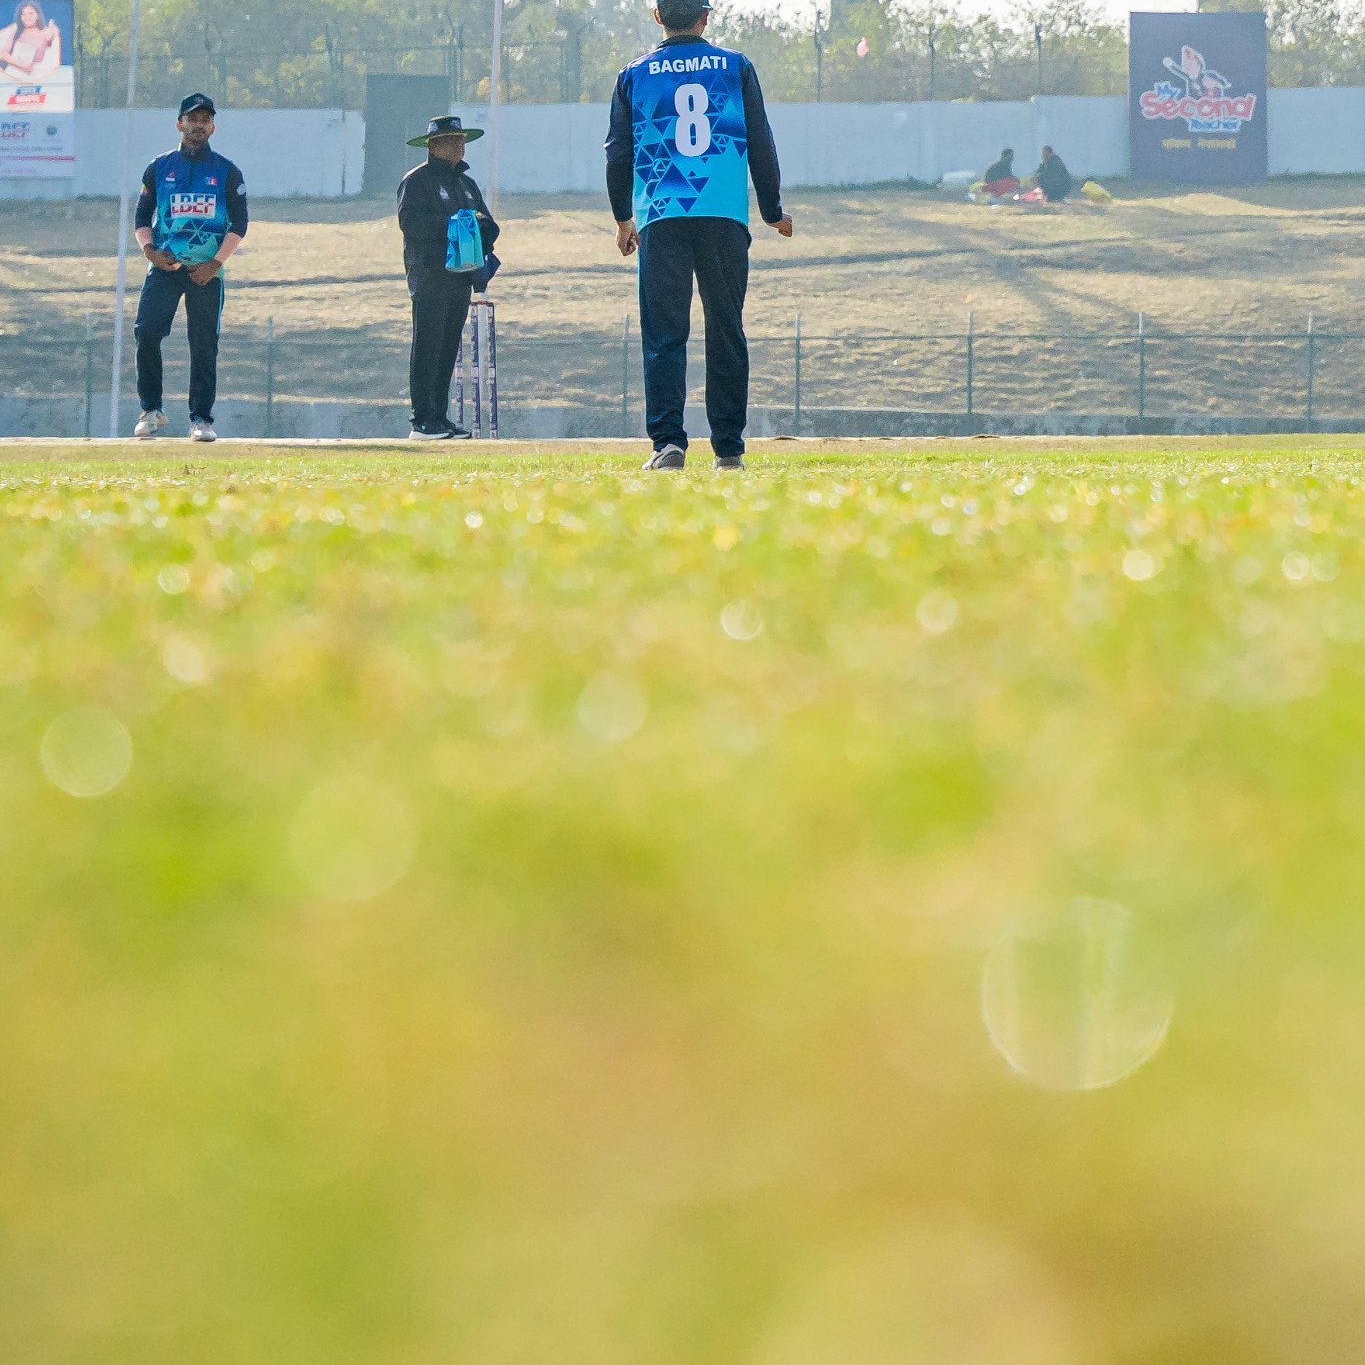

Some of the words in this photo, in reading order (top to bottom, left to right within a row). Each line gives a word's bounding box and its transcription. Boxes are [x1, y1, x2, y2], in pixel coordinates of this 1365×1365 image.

[648, 55, 728, 75] BAGMATI
[674, 83, 712, 157] 8
[1140, 90, 1257, 122] Second
